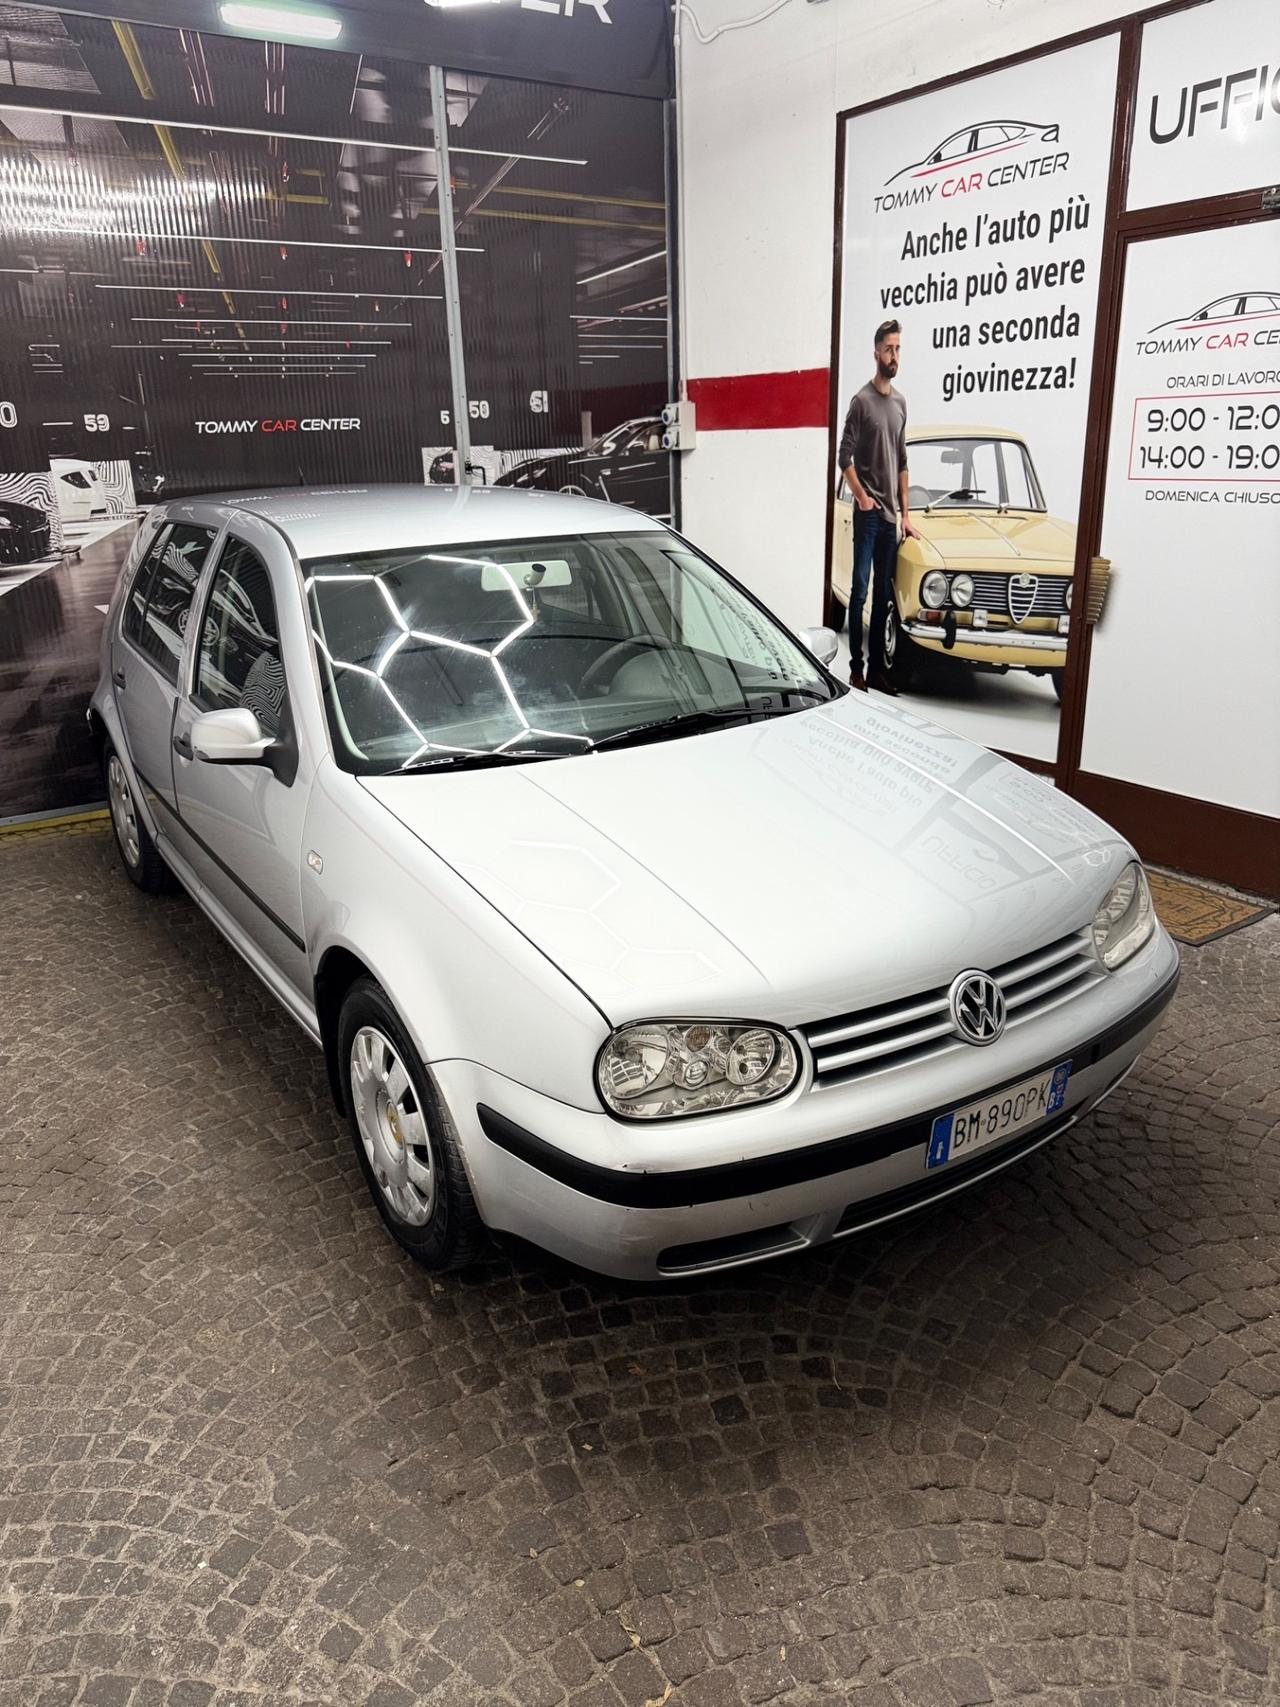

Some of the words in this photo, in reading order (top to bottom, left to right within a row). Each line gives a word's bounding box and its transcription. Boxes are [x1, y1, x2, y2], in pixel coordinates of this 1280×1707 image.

[1149, 64, 1280, 144] UFFI
[874, 183, 938, 213] TOMMY
[941, 173, 983, 197] CAR
[987, 152, 1070, 187] CENTER
[901, 222, 968, 260] Anche
[975, 210, 1041, 247] l'auto
[1049, 194, 1090, 243] più
[880, 272, 958, 309] vecchia
[965, 262, 1008, 306] può
[1016, 258, 1085, 292] avere
[932, 324, 970, 349] una
[978, 304, 1080, 346] seconda
[1136, 336, 1203, 355] TOMMY
[1206, 332, 1249, 350] CAR
[1253, 329, 1280, 345] CE
[943, 357, 1077, 402] giovinezza!
[1166, 374, 1209, 389] ORARI
[1212, 373, 1225, 386] DI
[83, 414, 110, 432] 59
[195, 420, 258, 434] TOMMY
[261, 419, 297, 432] CAR
[300, 418, 361, 431] CENTER
[1147, 407, 1206, 432] 9:00
[1140, 445, 1205, 469] 14:00
[1145, 490, 1220, 503] DOMENICA
